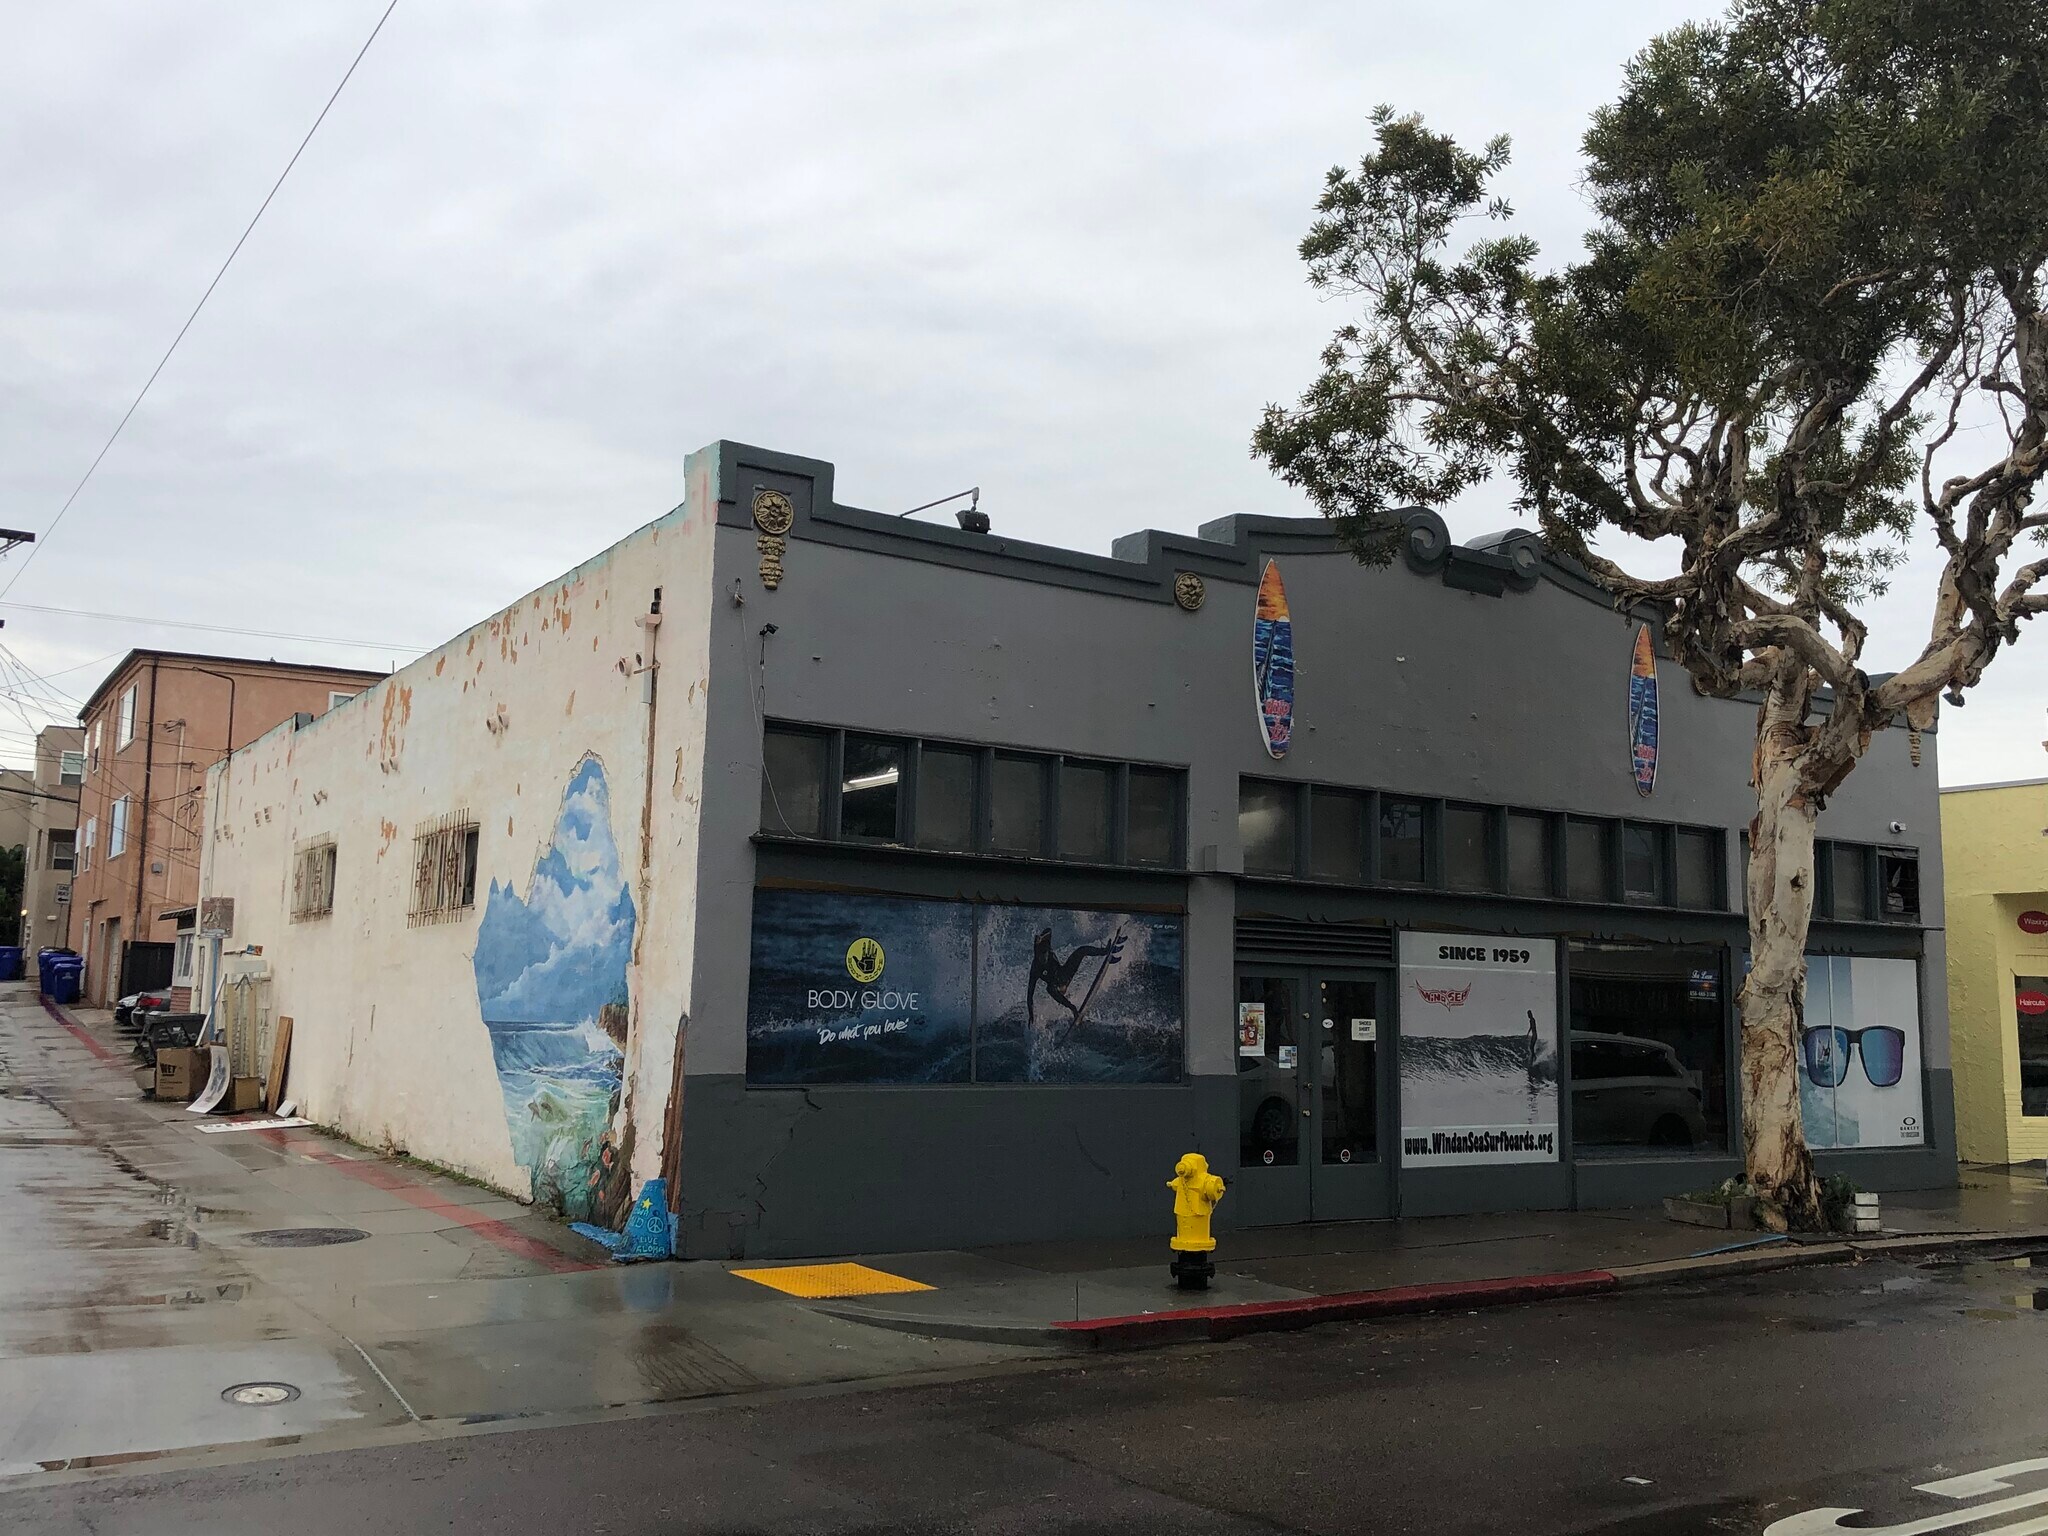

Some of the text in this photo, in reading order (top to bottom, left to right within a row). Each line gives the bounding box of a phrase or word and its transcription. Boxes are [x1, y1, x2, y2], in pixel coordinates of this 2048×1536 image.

[2024, 917, 2048, 927] Waxing
[1438, 945, 1531, 964] SINCE 1959
[808, 989, 919, 1010] BODY GLOVE
[2019, 998, 2046, 1006] Haircuts
[838, 1023, 865, 1041] what
[863, 1024, 881, 1041] you
[1404, 1130, 1554, 1155] www.WindanSeaSurfboards.org
[640, 1236, 659, 1245] LIVE
[635, 1245, 666, 1254] ALOHA
